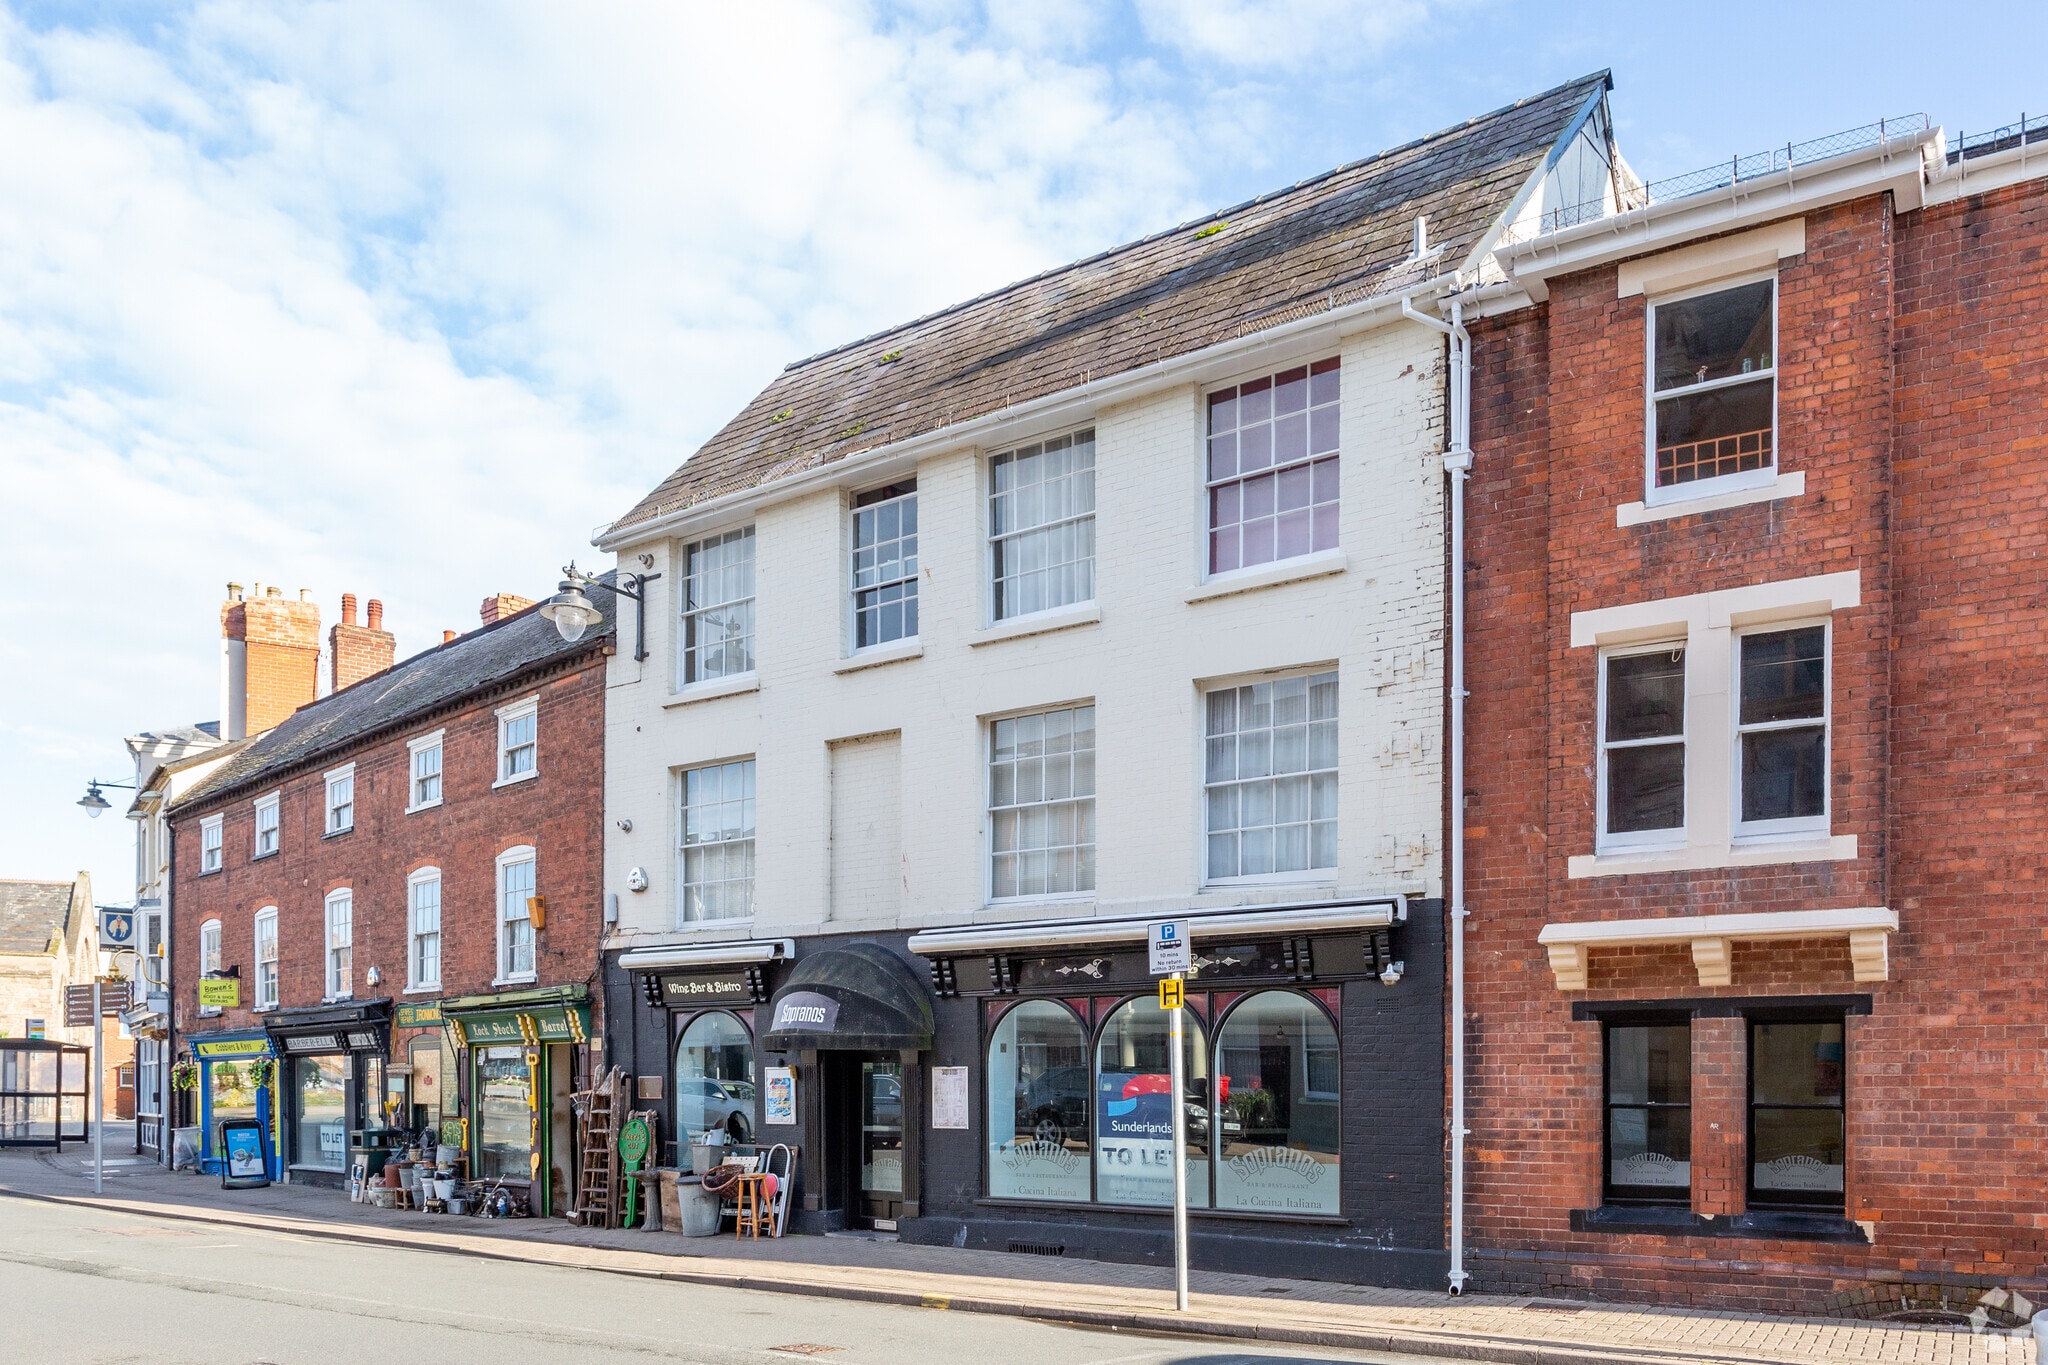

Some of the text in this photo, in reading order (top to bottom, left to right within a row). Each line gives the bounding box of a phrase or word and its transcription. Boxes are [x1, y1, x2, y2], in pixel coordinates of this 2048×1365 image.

[1164, 926, 1173, 938] P
[204, 983, 233, 993] Bowen's
[668, 982, 742, 994] Wine Bar & Bistro
[780, 1004, 826, 1024] Sopranos
[471, 1022, 517, 1038] Lock Stock
[540, 1019, 569, 1034] Barrel
[216, 1044, 236, 1052] Cobblers
[240, 1043, 252, 1052] Keys
[286, 1036, 336, 1049] BARBER-ELLA
[1112, 1120, 1172, 1134] Sunderlands
[322, 1132, 343, 1144] TO LET
[1001, 1140, 1080, 1174] Sopranos
[1102, 1147, 1172, 1167] TO LE
[1622, 1152, 1679, 1172] Sopranos
[1228, 1146, 1326, 1184] Sopranos
[1766, 1155, 1830, 1176] Sopranos
[1018, 1185, 1044, 1195] Cucina
[1048, 1186, 1077, 1197] Italiana
[1236, 1196, 1322, 1209] La Cucina Italiana
